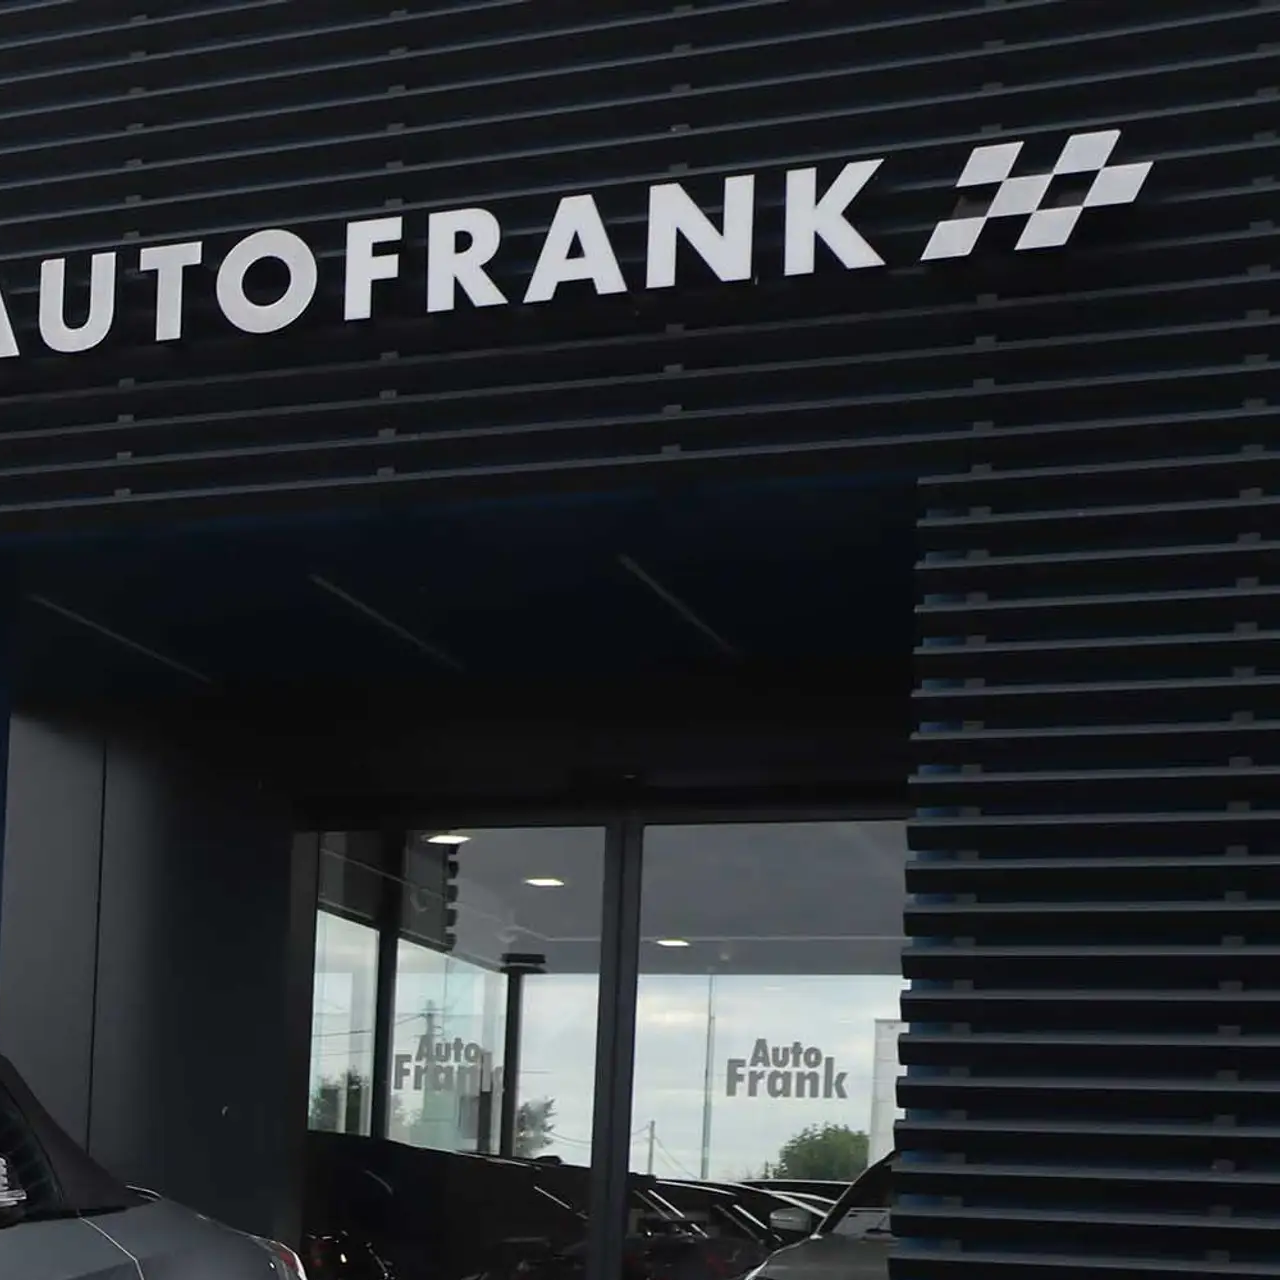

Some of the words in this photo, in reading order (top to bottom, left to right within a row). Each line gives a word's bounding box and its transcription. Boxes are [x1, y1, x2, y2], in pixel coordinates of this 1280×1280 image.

[415, 1035, 482, 1063] Auto
[750, 1038, 823, 1069] Auto
[726, 1057, 849, 1099] Frank
